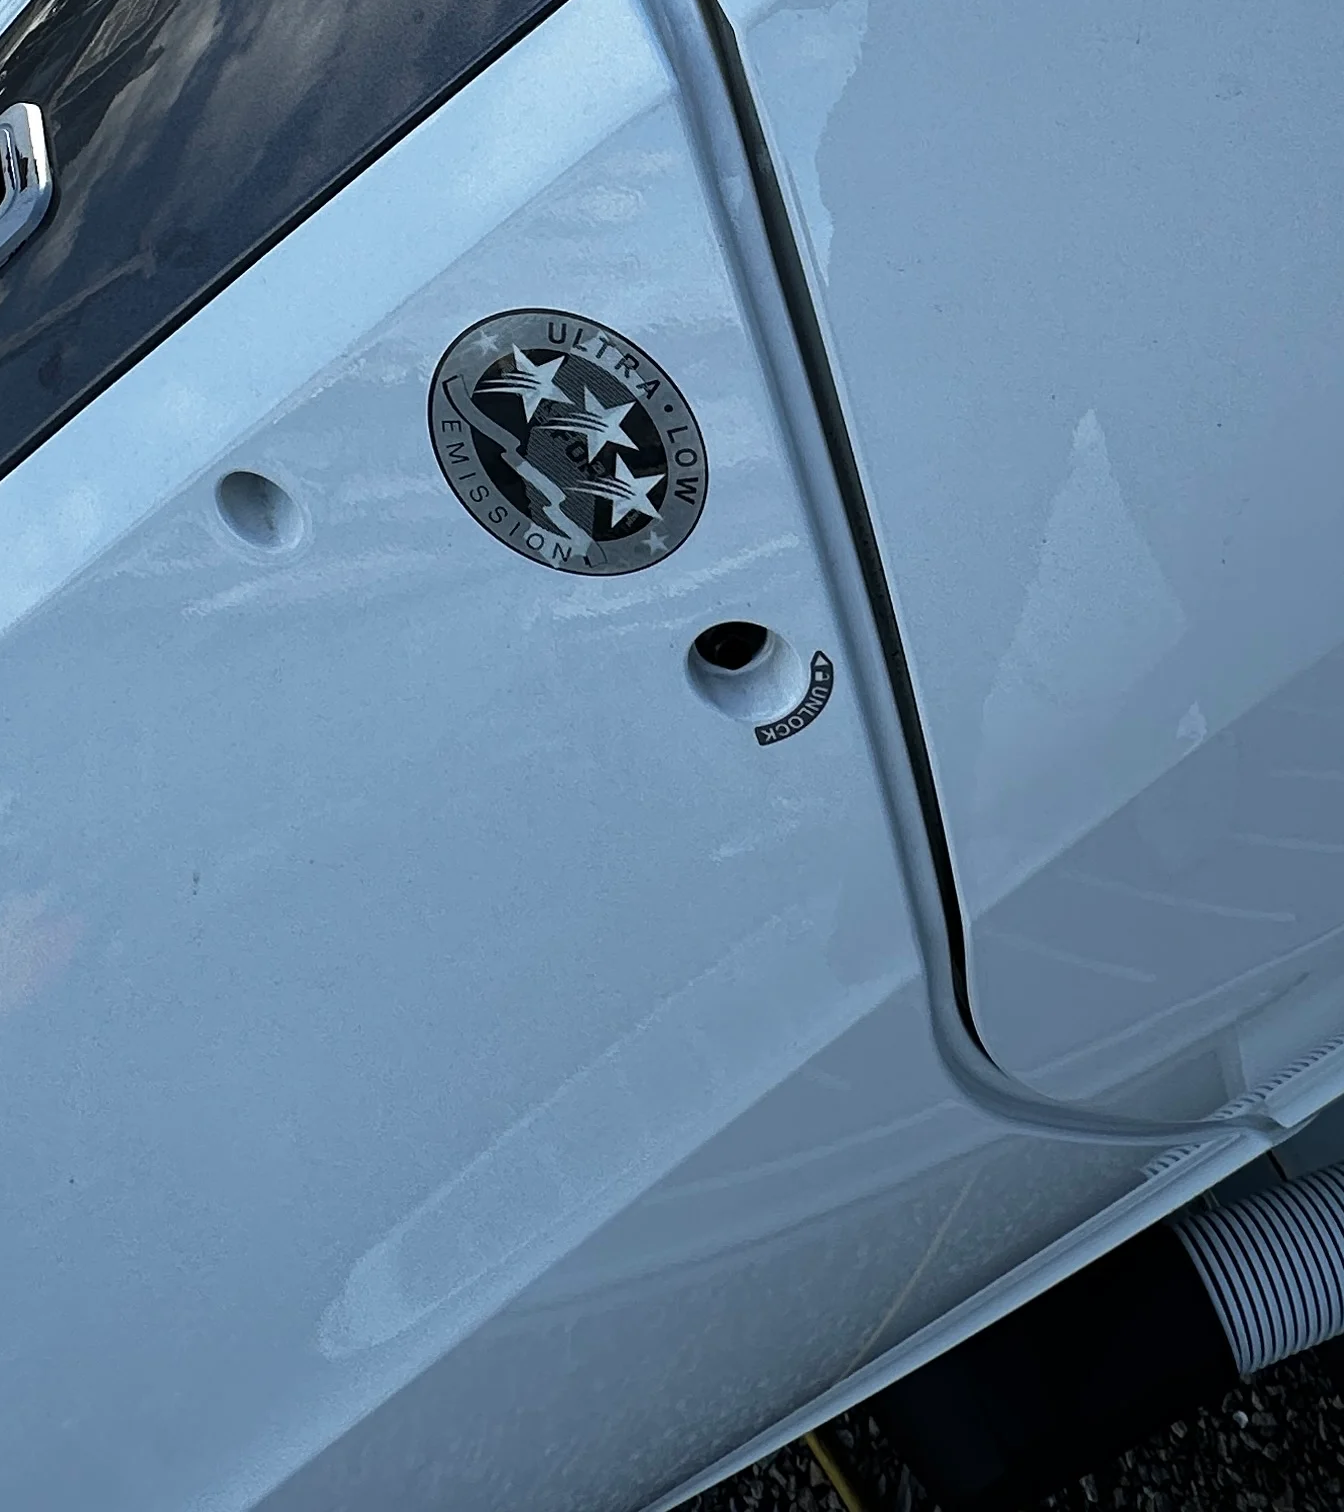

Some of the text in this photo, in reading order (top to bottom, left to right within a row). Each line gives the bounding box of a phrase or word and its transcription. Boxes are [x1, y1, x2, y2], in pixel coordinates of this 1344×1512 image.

[547, 321, 662, 401] ULTRA
[666, 425, 700, 506] LOW
[441, 419, 573, 563] EMISSION
[760, 686, 829, 742] UNLOCK
